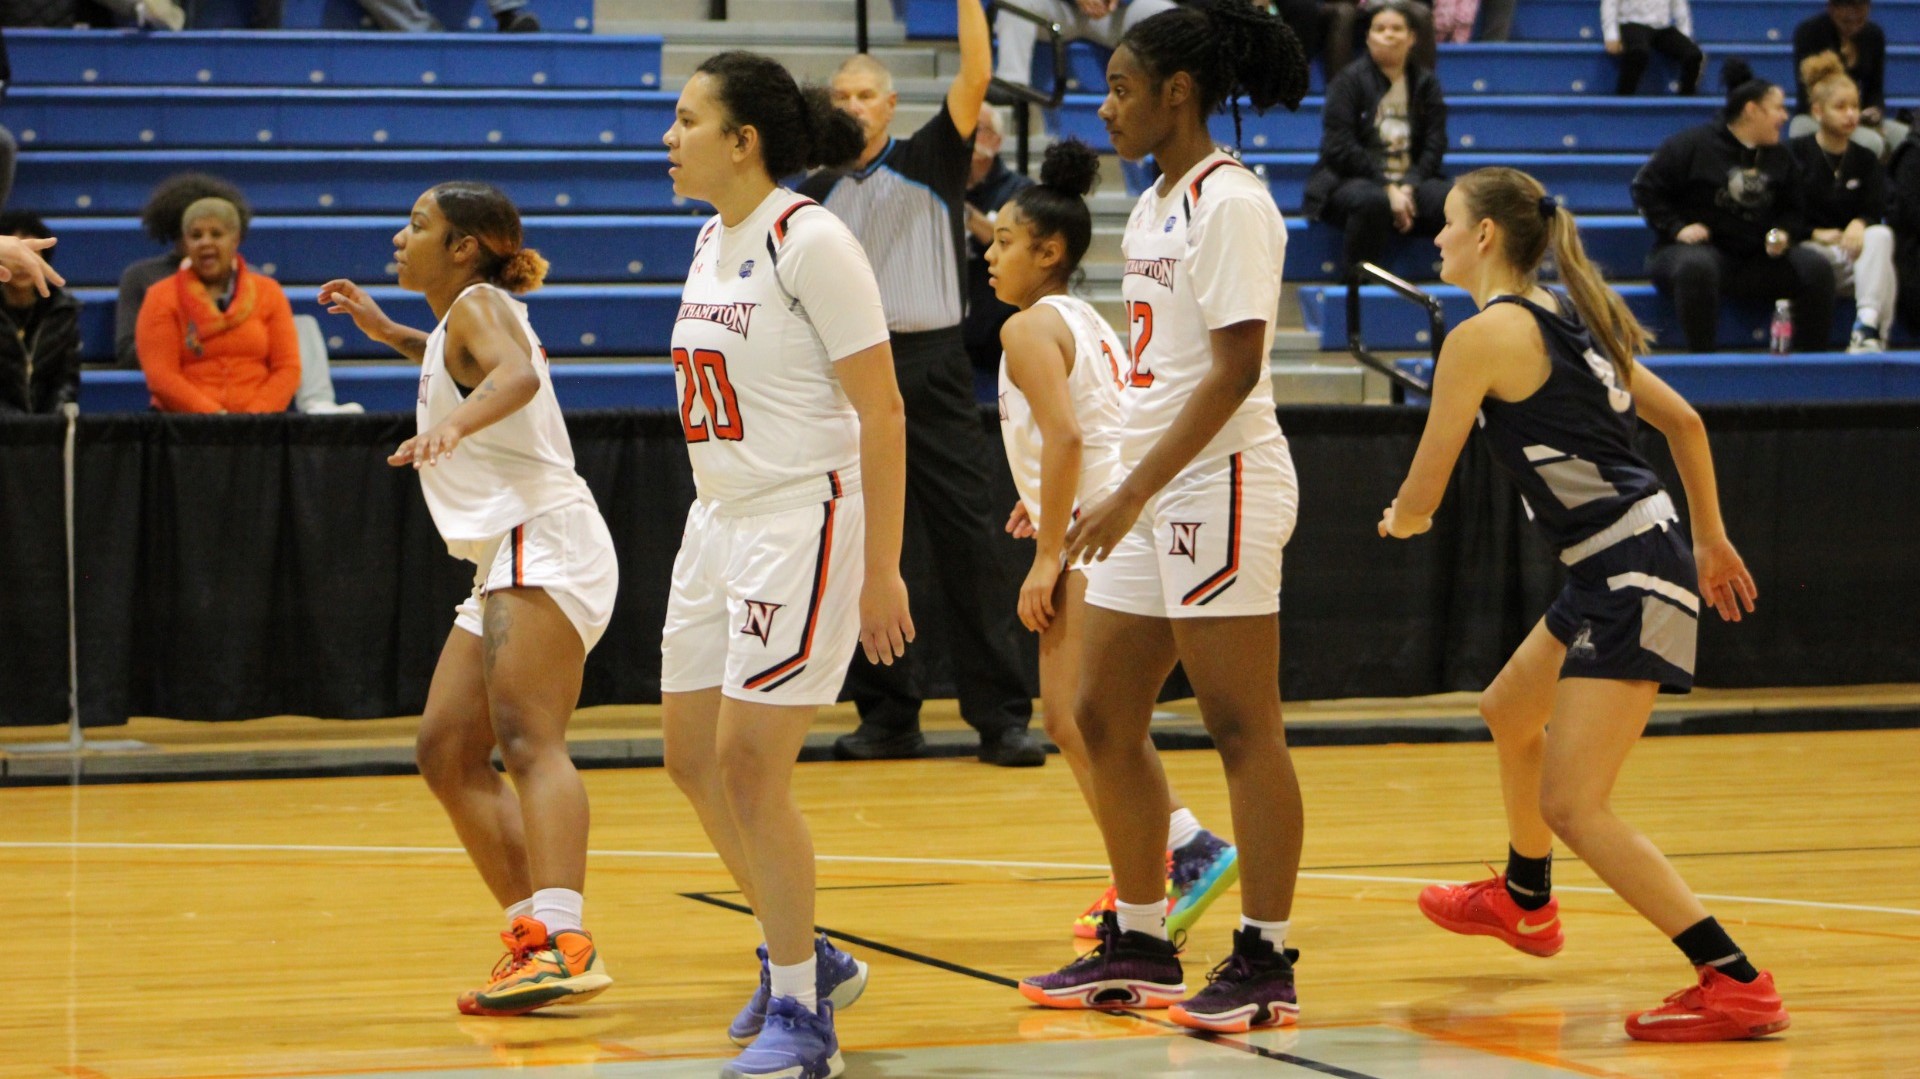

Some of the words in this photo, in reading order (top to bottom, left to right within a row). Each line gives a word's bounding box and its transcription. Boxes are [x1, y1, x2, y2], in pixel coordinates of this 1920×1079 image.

[672, 347, 744, 443] 20
[1168, 522, 1202, 565] N
[740, 599, 783, 648] N
